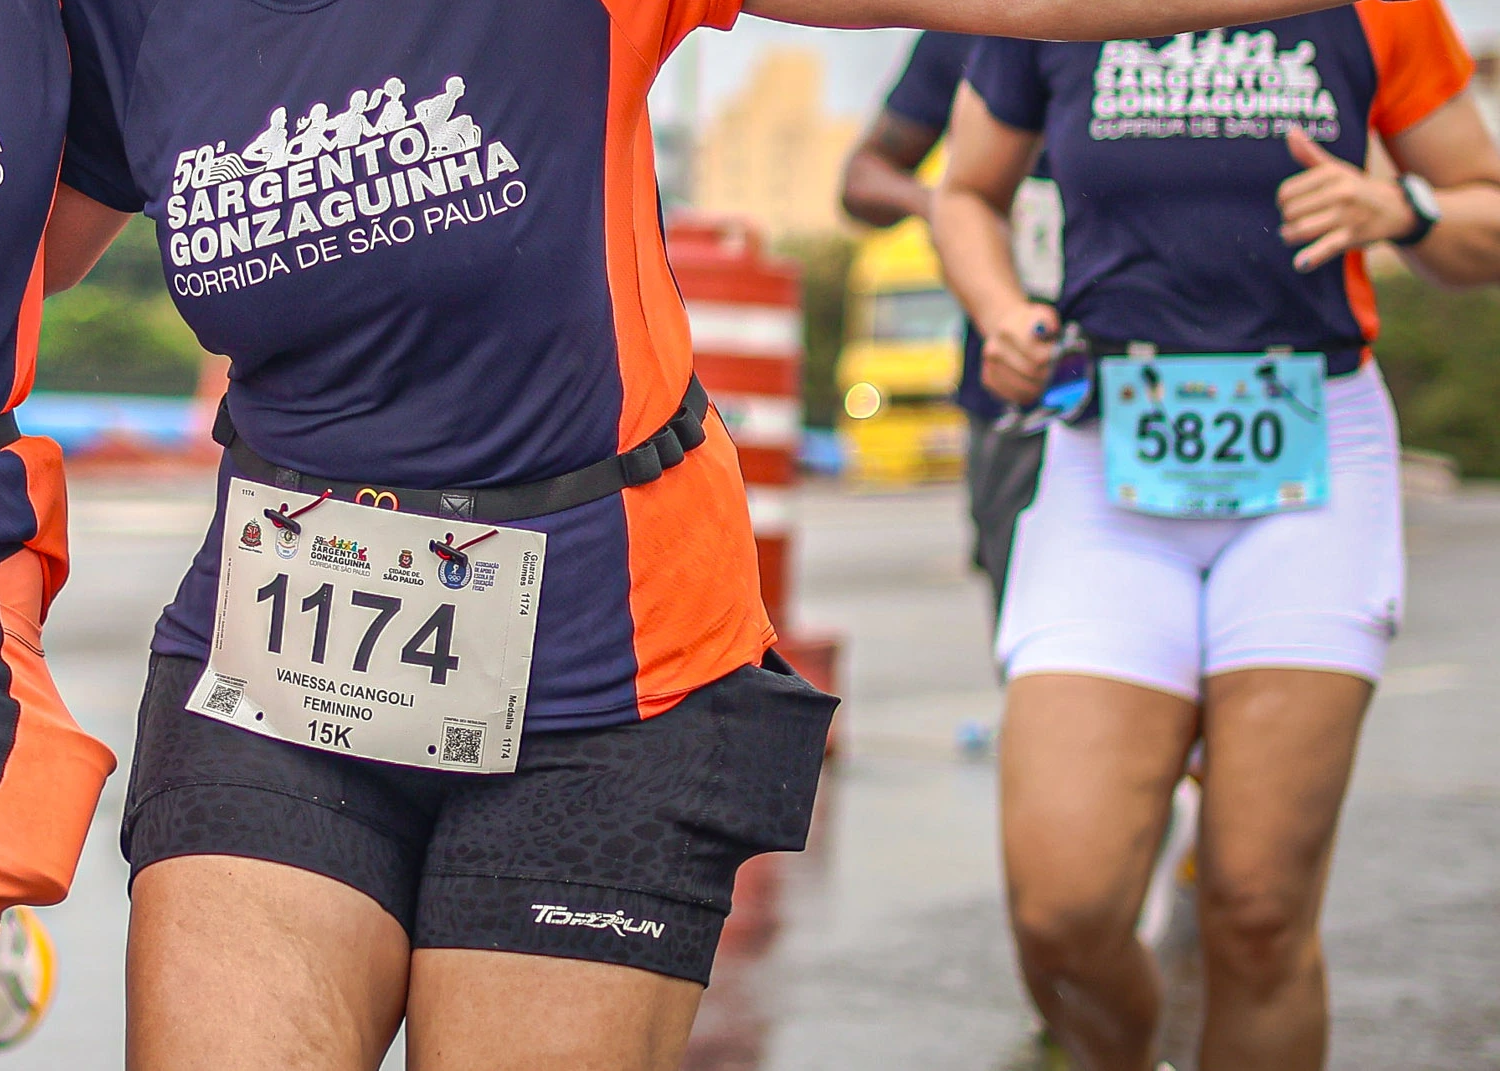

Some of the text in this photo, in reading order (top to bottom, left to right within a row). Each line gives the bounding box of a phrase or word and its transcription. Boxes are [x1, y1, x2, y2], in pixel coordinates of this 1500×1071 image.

[1092, 89, 1338, 118] GONZAGUINHA
[166, 126, 429, 230] SARGENTO
[169, 140, 521, 268] GONZAGUINHA
[173, 179, 528, 298] CORRIDA DE SÃO PAULO
[1136, 410, 1284, 464] 5820
[241, 488, 256, 497] 1174
[310, 550, 372, 571] GONZAGUINHA
[311, 543, 359, 560] SARGENTO
[382, 572, 425, 587] SÃO PAULO
[388, 567, 411, 578] CIDADE
[519, 551, 532, 616] Volumes 1174
[527, 554, 539, 585] Guarda
[256, 572, 460, 686] 1174
[276, 667, 337, 695] VANESSA
[339, 682, 415, 709] CIANGOLI
[303, 695, 374, 722] FEMININO
[307, 719, 354, 750] 15K
[500, 694, 518, 760] Medalha 1174
